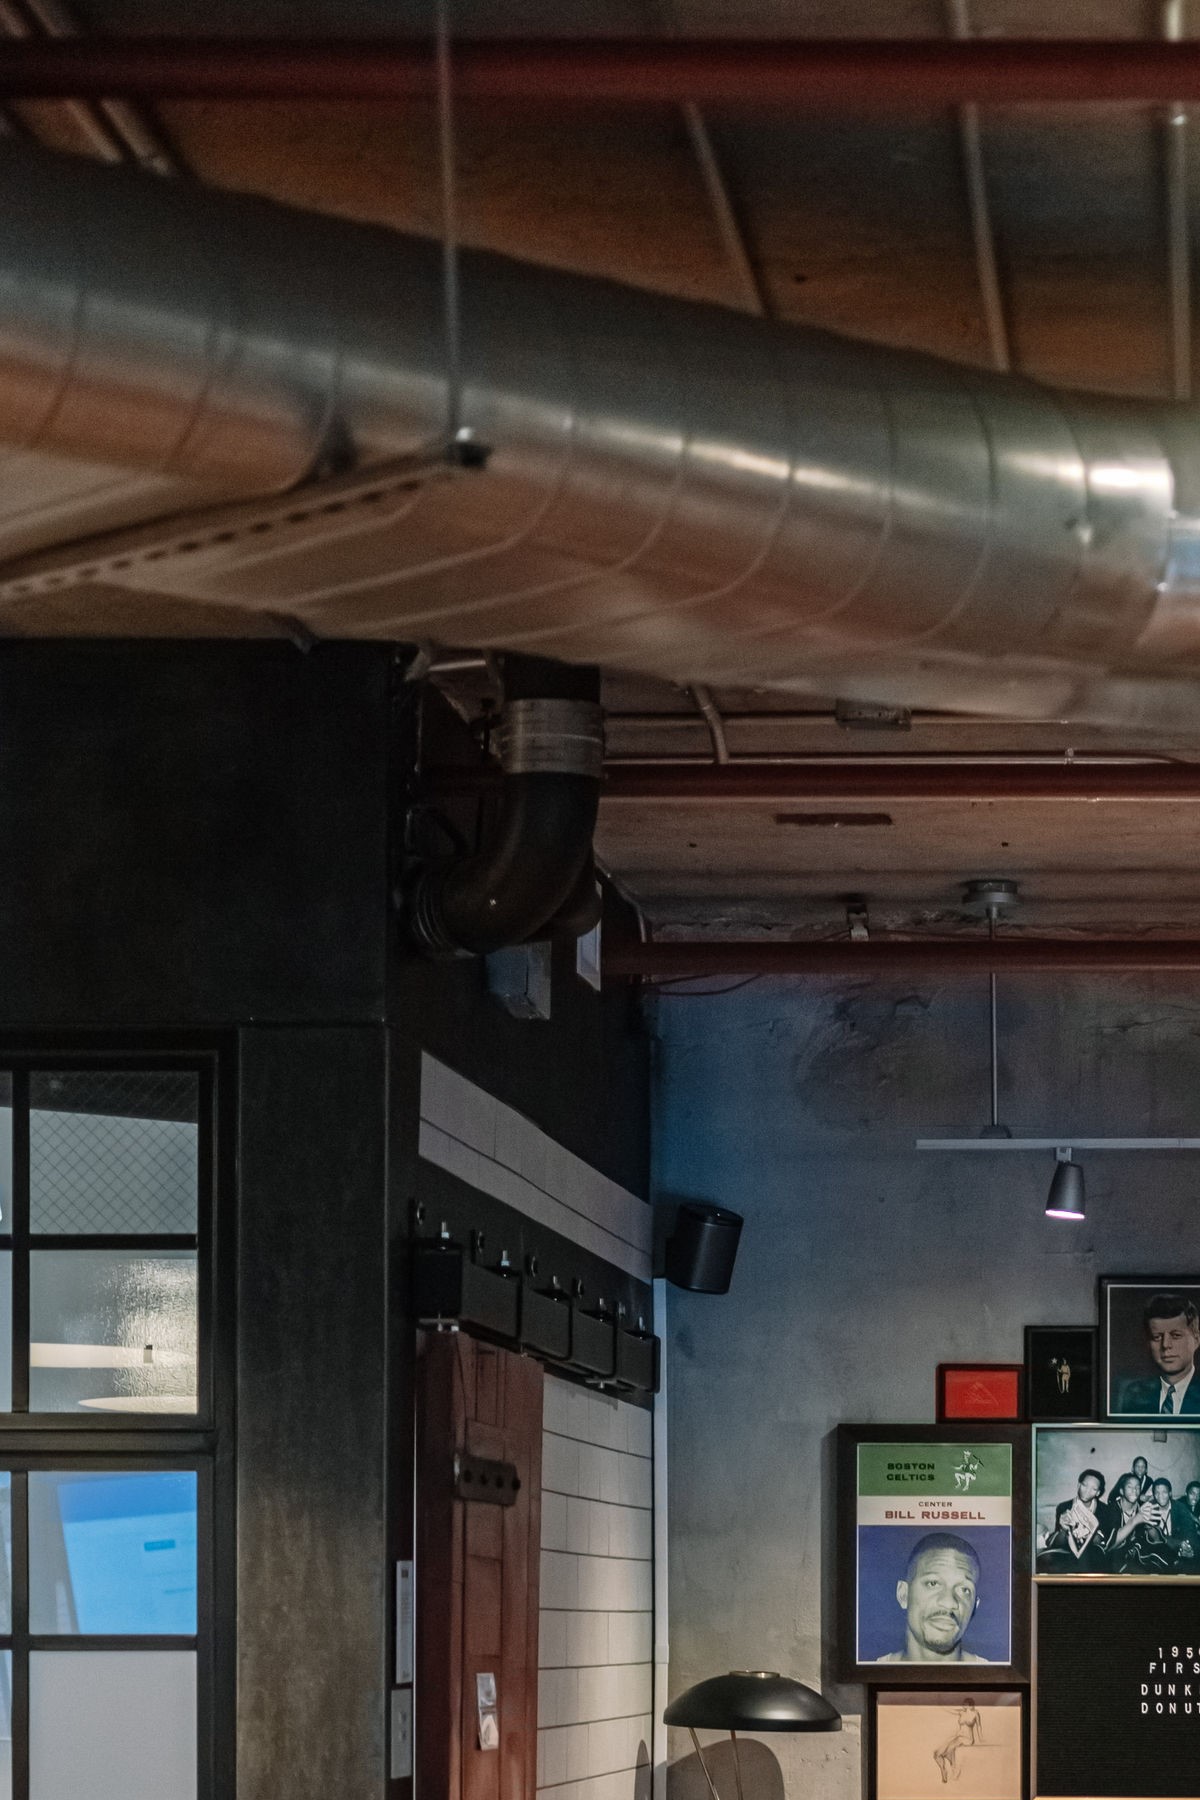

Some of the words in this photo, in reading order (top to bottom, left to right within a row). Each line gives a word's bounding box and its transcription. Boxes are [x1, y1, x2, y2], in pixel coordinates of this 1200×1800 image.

[887, 1462, 935, 1470] BOSTON
[886, 1473, 935, 1481] CELTICS
[884, 1510, 916, 1519] BILL
[921, 1511, 986, 1520] RUSSELL
